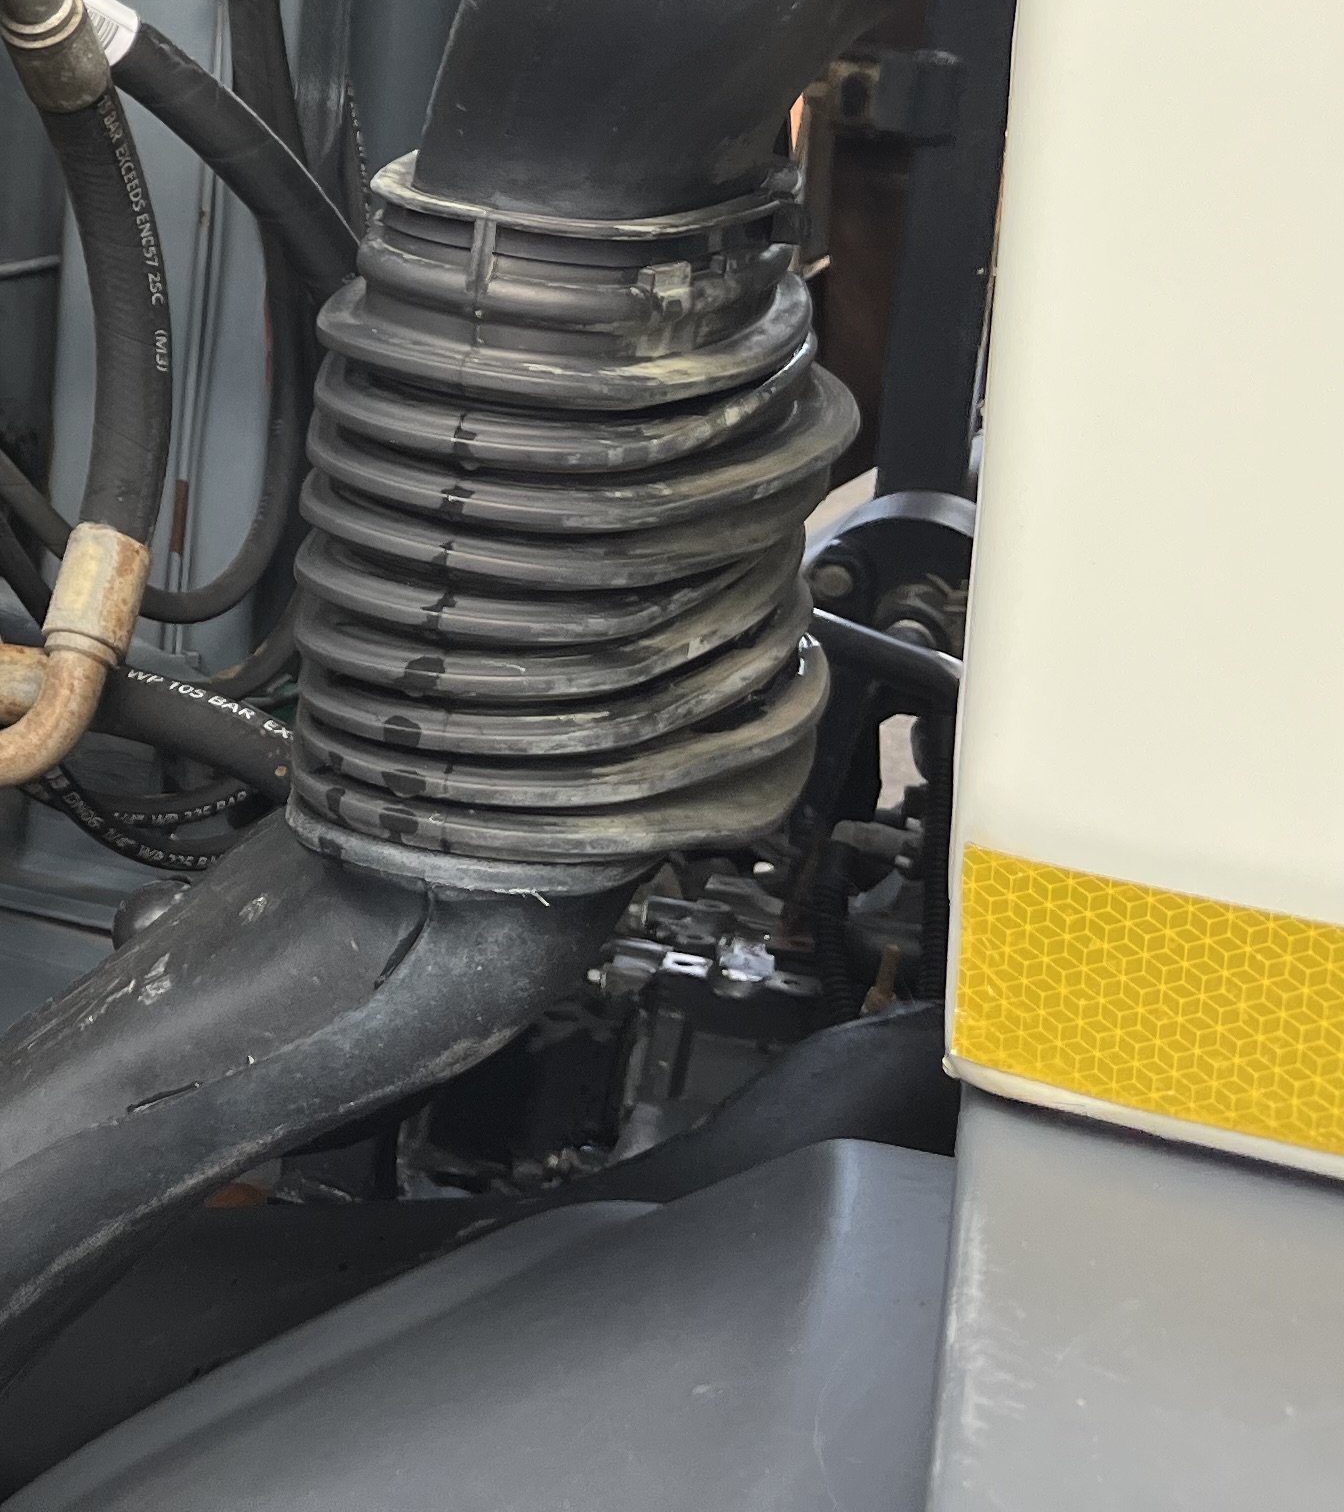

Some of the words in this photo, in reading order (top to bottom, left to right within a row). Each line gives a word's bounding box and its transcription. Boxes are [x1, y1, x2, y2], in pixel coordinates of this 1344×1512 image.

[104, 114, 123, 144] BAR
[115, 142, 146, 212] EXCEEDS
[148, 271, 165, 305] 2SC
[128, 669, 164, 684] WP
[169, 681, 207, 699] 105
[208, 696, 256, 720] BAR
